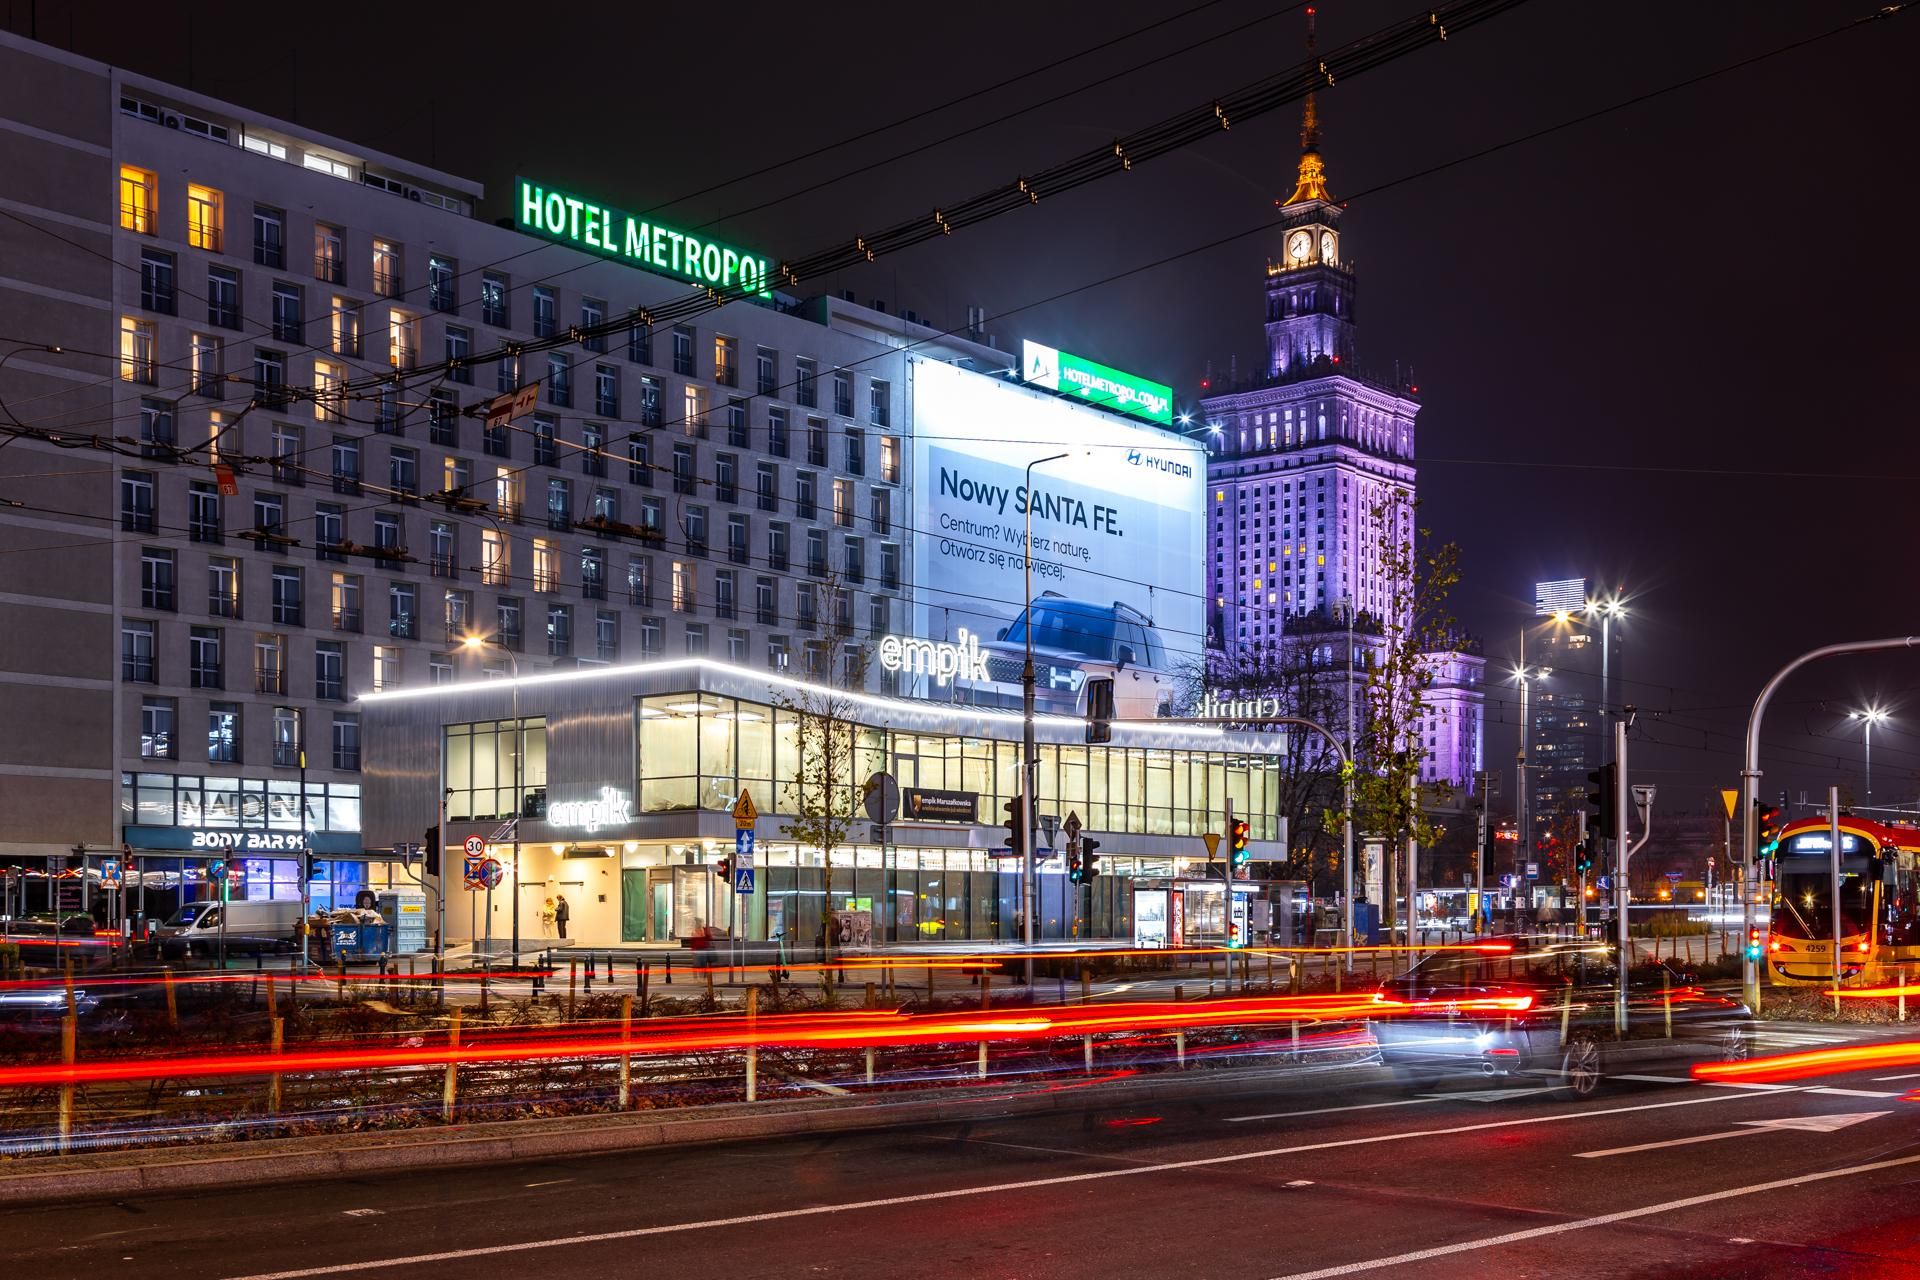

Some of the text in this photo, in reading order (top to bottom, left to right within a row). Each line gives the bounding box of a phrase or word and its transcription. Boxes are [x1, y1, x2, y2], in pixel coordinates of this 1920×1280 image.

[522, 182, 773, 300] HOTEL METROPOL
[1145, 455, 1192, 479] HYUNDAI
[940, 466, 1124, 537] Nowy SANTA FE.
[939, 512, 1000, 540] Centrum?
[1052, 539, 1092, 563] naturę.
[939, 538, 986, 562] Otwórz
[988, 551, 1005, 570] się
[1008, 555, 1024, 570] na
[879, 627, 992, 687] empik
[548, 785, 632, 833] empik
[921, 796, 937, 806] empik
[191, 831, 244, 848] BODY
[247, 833, 285, 850] BAR
[467, 840, 483, 852] 30
[1805, 944, 1827, 953] 4259
